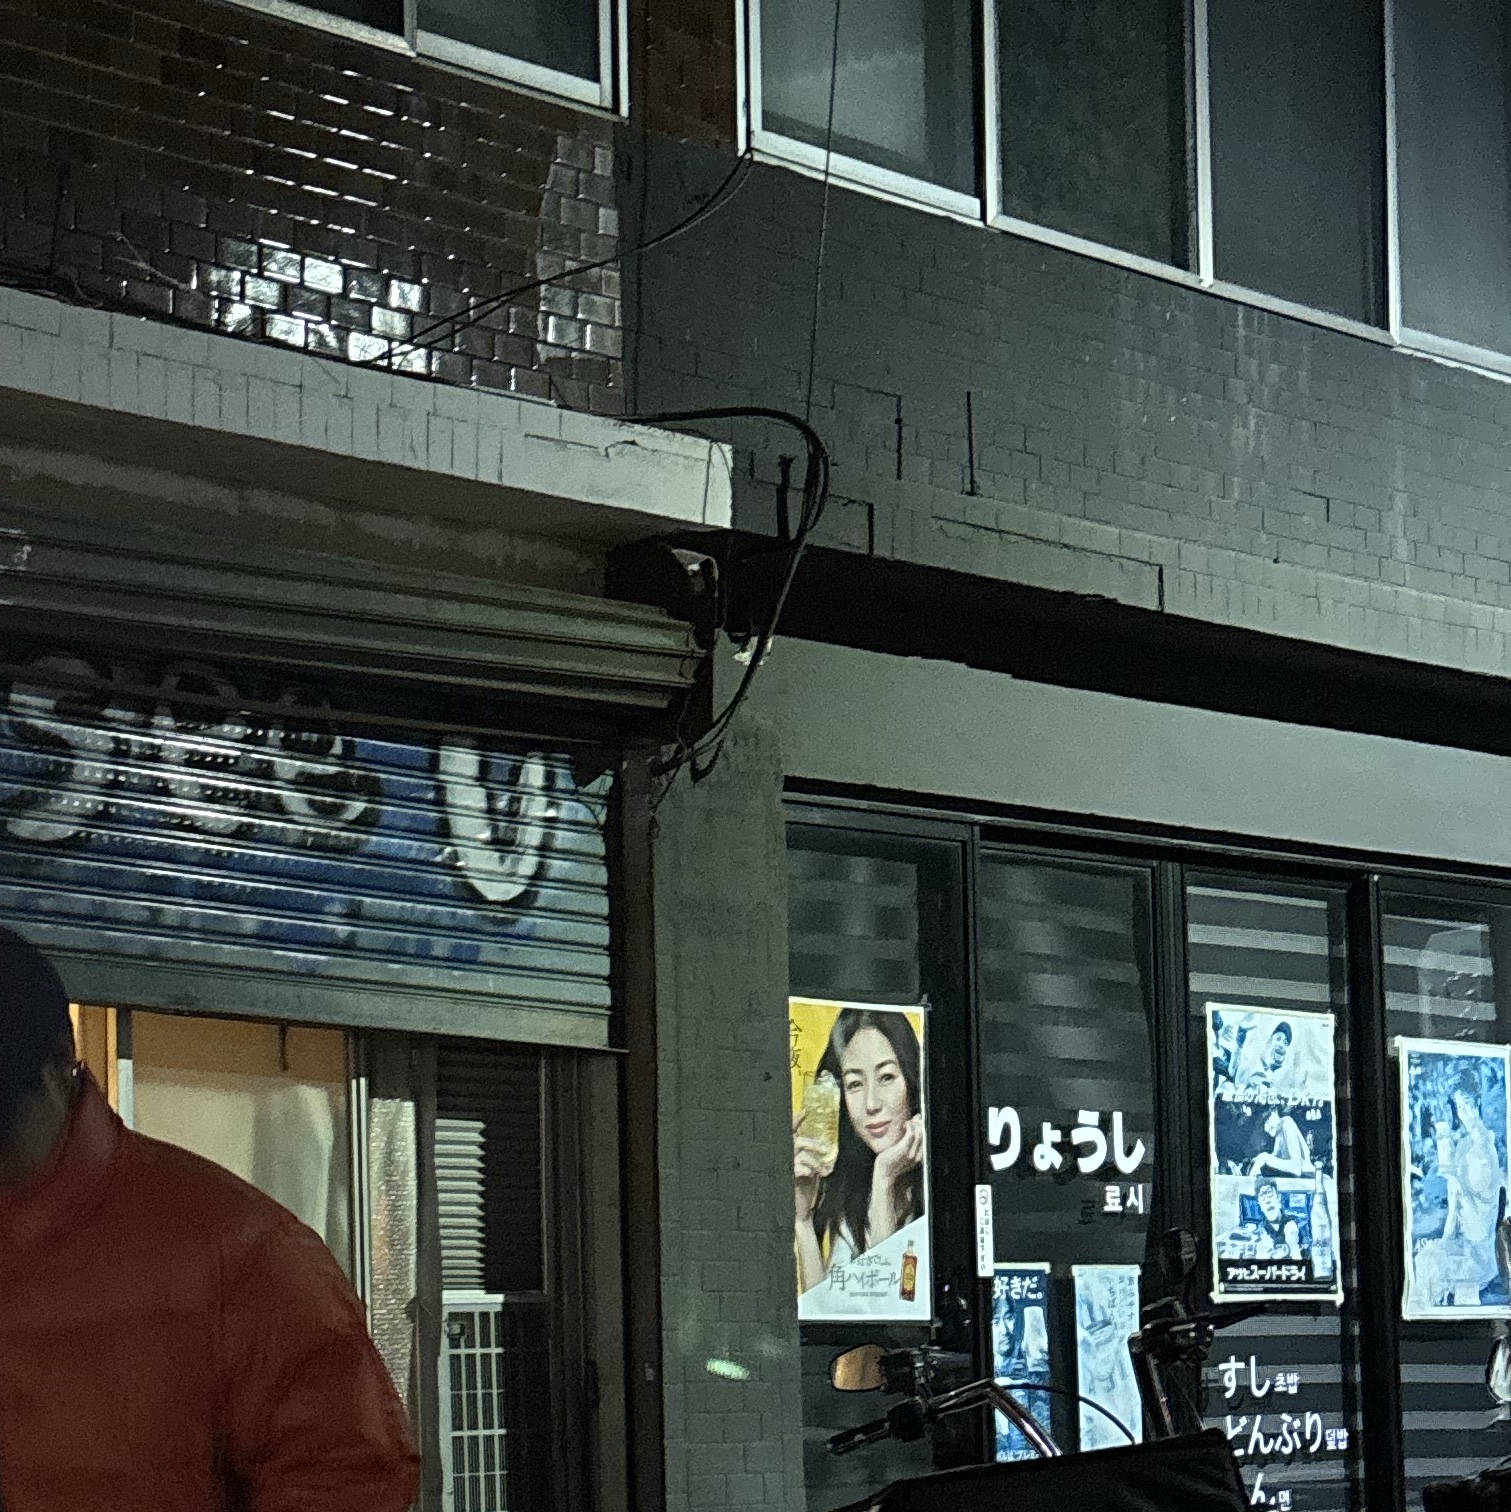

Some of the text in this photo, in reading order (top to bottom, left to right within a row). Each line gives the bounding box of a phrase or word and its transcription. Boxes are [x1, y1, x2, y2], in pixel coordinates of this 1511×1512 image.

[988, 1106, 1146, 1174] りょうし
[1103, 1183, 1144, 1214] 료시
[993, 1276, 1044, 1300] 好きだ。
[1218, 1355, 1300, 1398] すし 초밥
[1226, 1411, 1322, 1456] どんぶり
